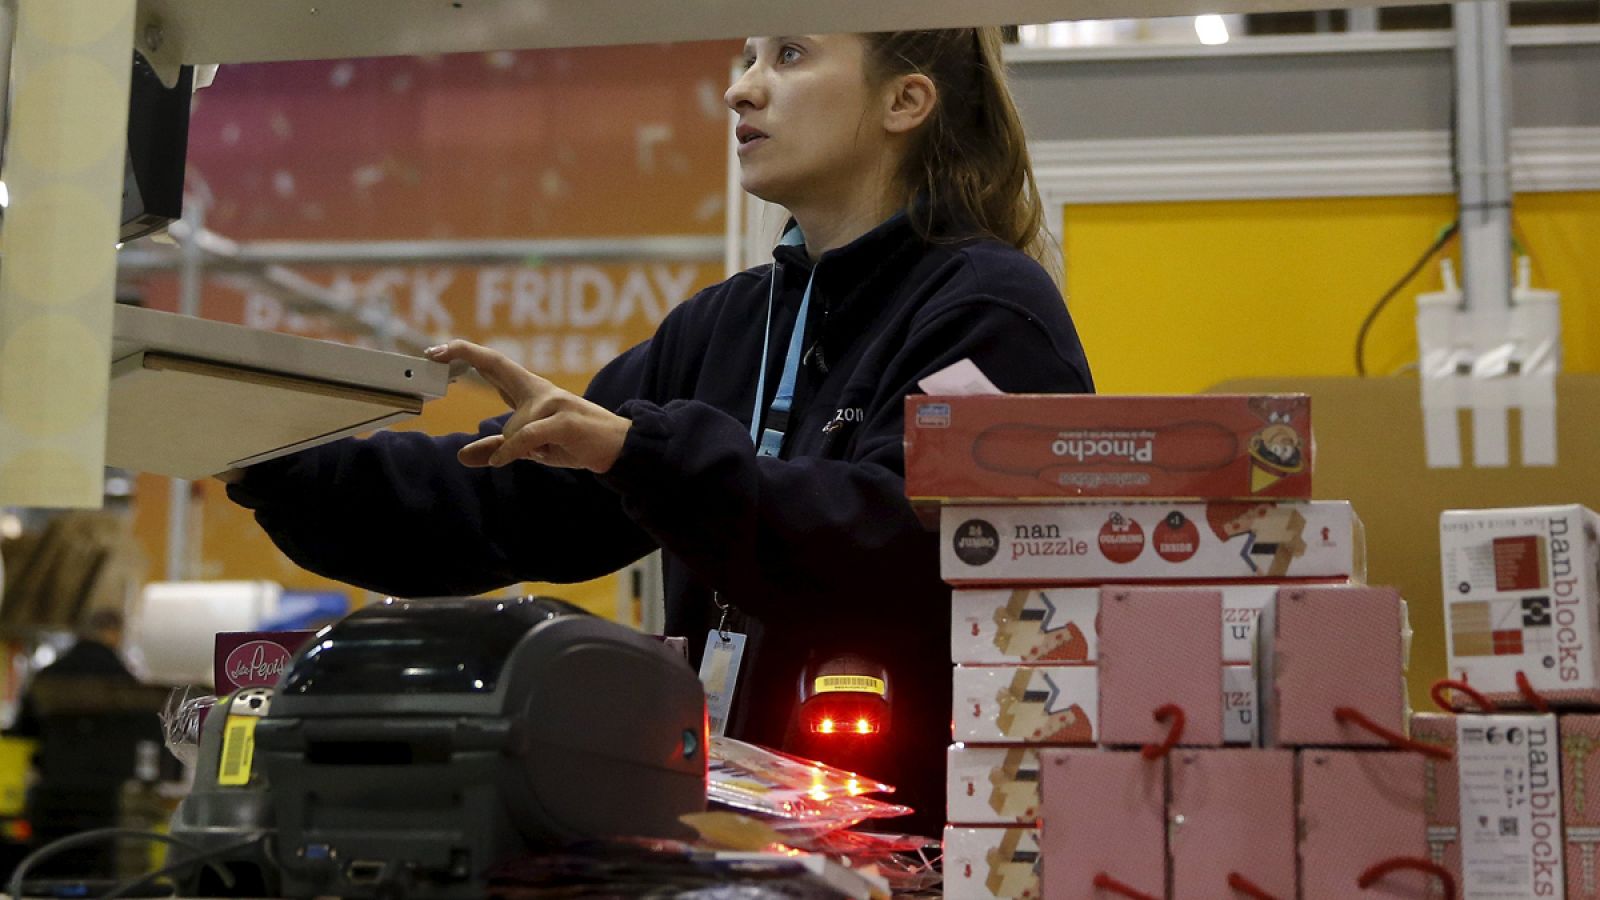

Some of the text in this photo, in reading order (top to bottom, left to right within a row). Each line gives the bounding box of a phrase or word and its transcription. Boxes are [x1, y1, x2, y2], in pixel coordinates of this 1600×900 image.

[475, 265, 701, 327] FRIDAY
[1051, 439, 1154, 462] Pinocho
[1010, 536, 1089, 560] puzzle
[1014, 523, 1061, 539] nan
[1549, 516, 1583, 682] nanblocks
[1528, 727, 1558, 897] nanblocks
